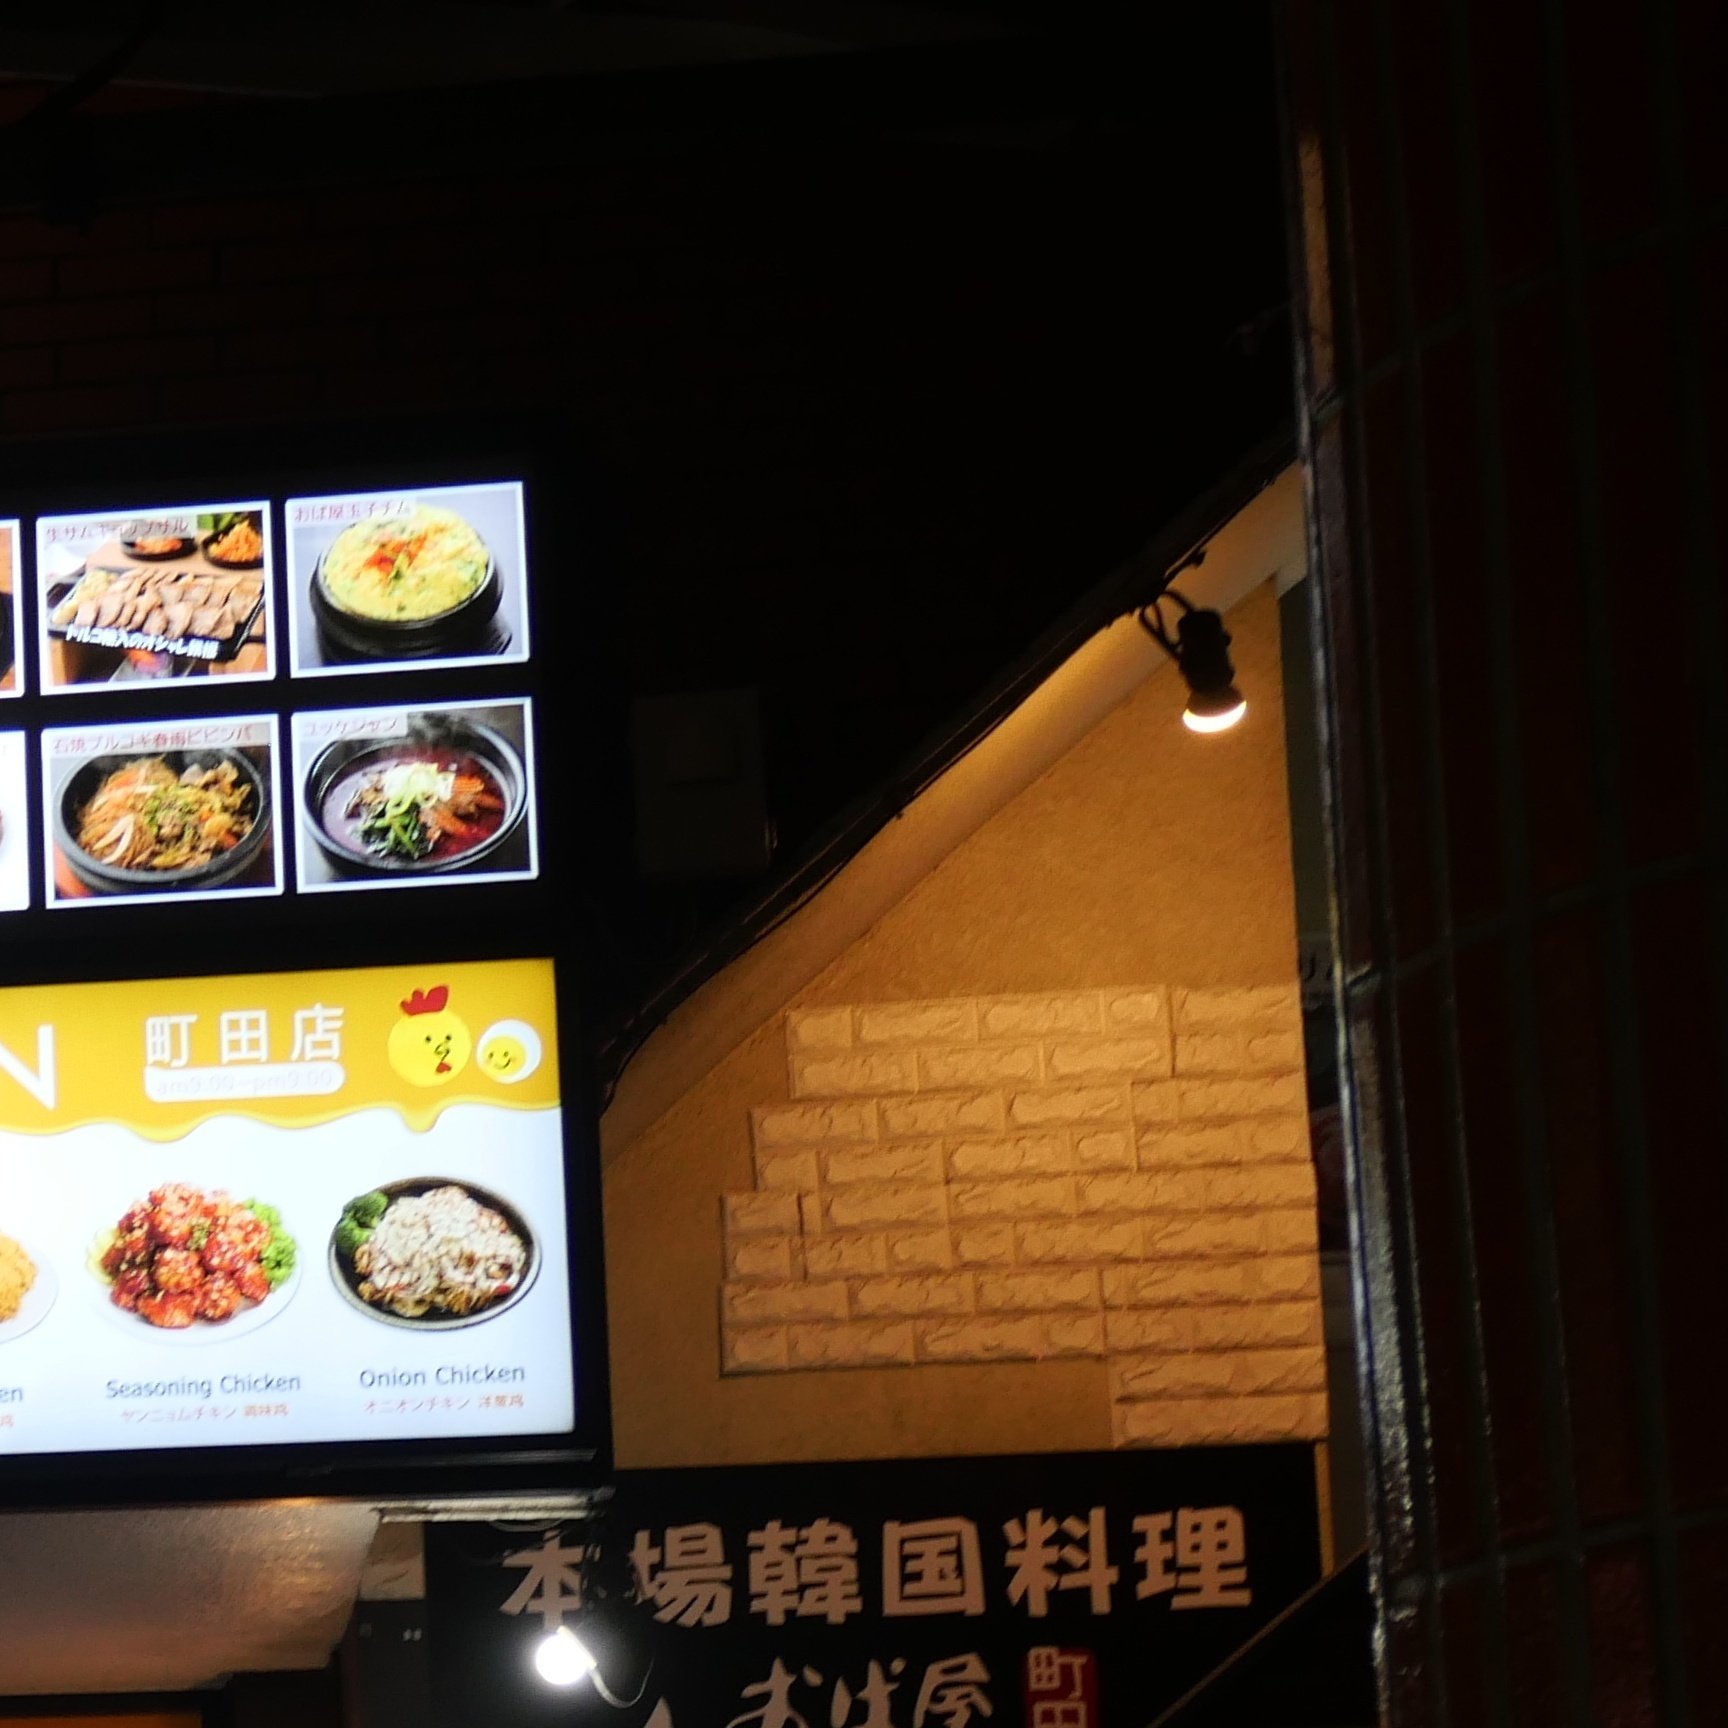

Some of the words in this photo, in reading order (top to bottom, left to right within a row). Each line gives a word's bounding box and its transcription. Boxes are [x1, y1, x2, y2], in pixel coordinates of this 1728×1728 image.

[146, 1003, 345, 1069] 町田店
[106, 1375, 212, 1400] Seasoning
[220, 1371, 302, 1394] Chicken
[359, 1368, 427, 1389] Onion
[435, 1364, 526, 1386] Chicken
[499, 1503, 1255, 1629] 本場韓国料理
